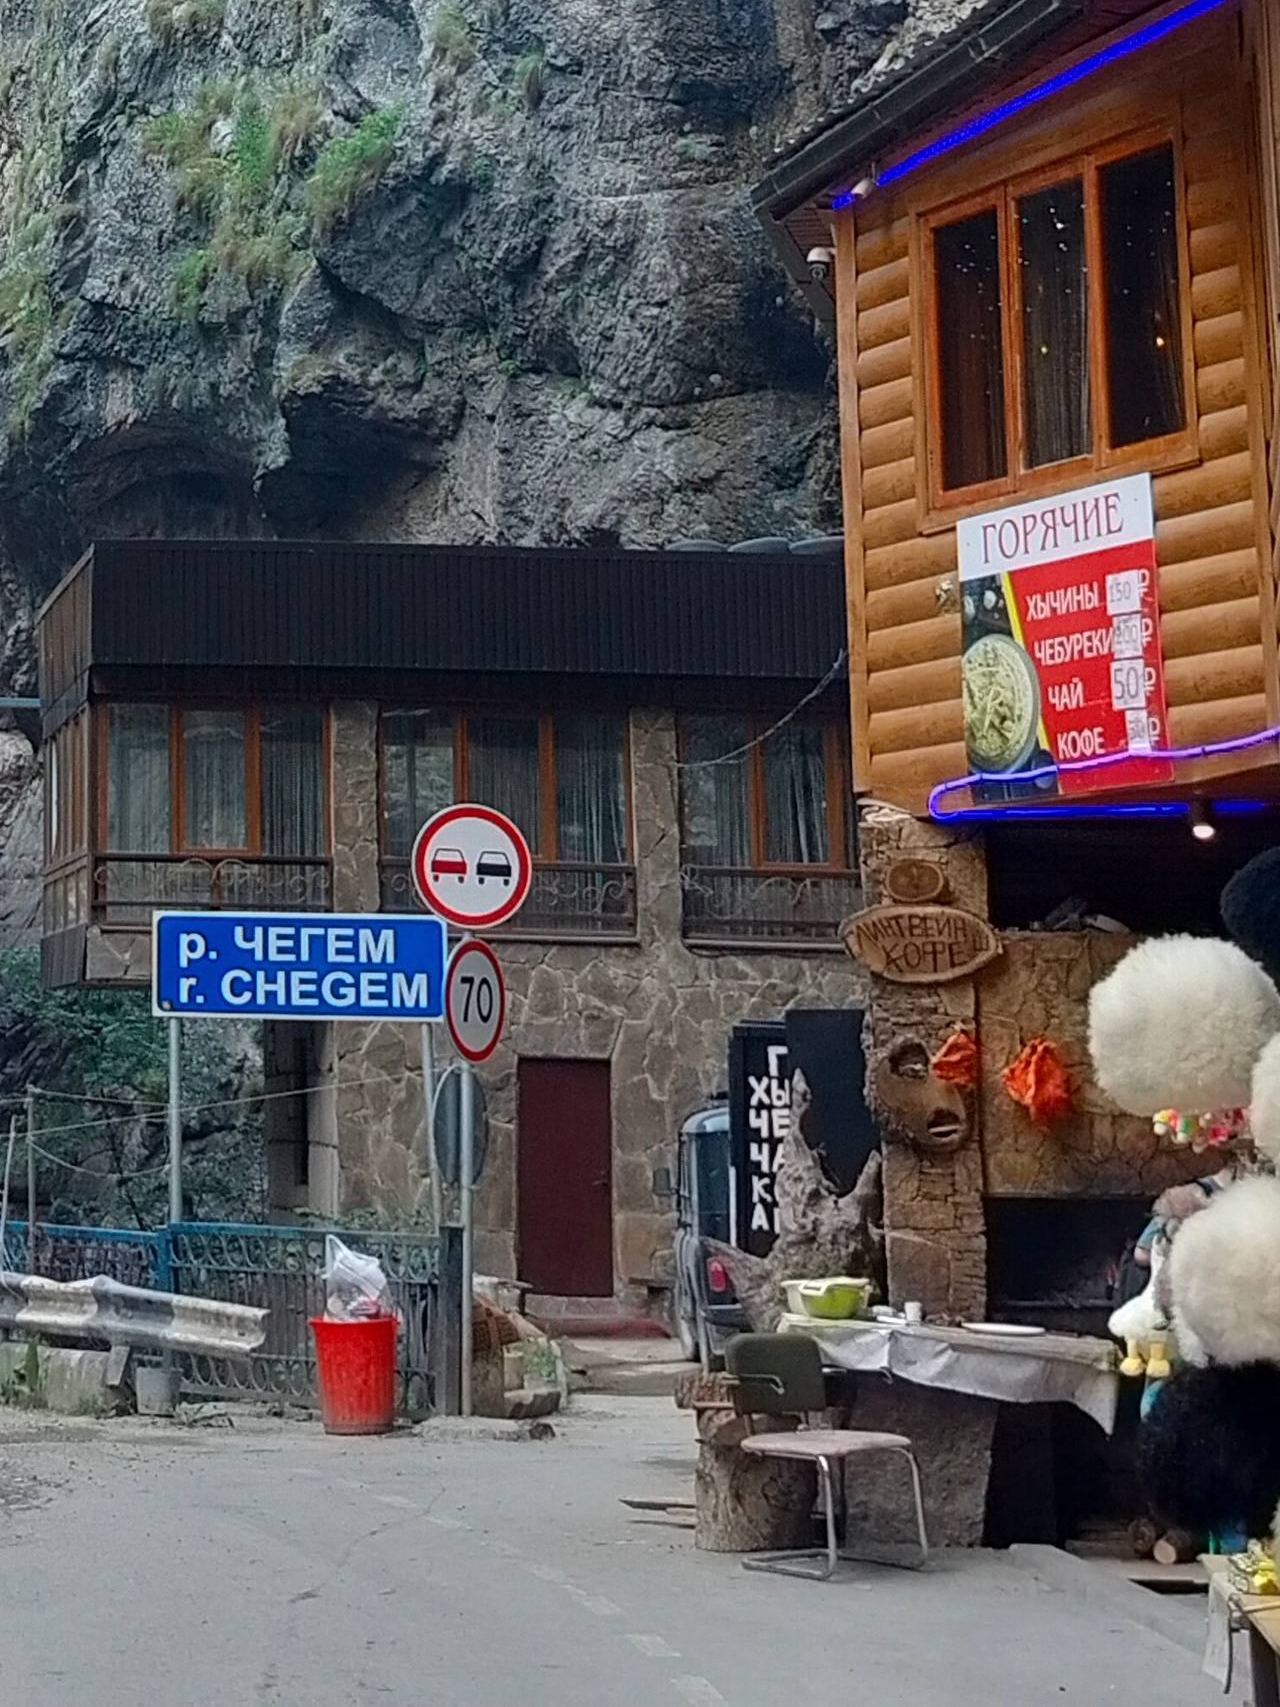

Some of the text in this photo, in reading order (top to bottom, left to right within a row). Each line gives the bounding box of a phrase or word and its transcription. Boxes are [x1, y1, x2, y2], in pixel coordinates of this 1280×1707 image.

[981, 492, 1124, 564] ГОРЯЧИЕ
[1025, 581, 1100, 622] ХЫЧИНЫ
[1109, 580, 1132, 603] 150
[1033, 627, 1115, 667] ЧЕБУРЕКИ
[1048, 677, 1084, 712] ЧАЙ
[1114, 666, 1138, 700] 50
[1056, 726, 1106, 760] КОФЕ
[179, 925, 395, 968] р. ЧЕГЕМ
[843, 910, 968, 959] ГЛИНТВЕЙН
[882, 941, 969, 973] КОФЕ
[179, 968, 428, 1008] r. CHEGEM
[460, 975, 493, 1024] 70
